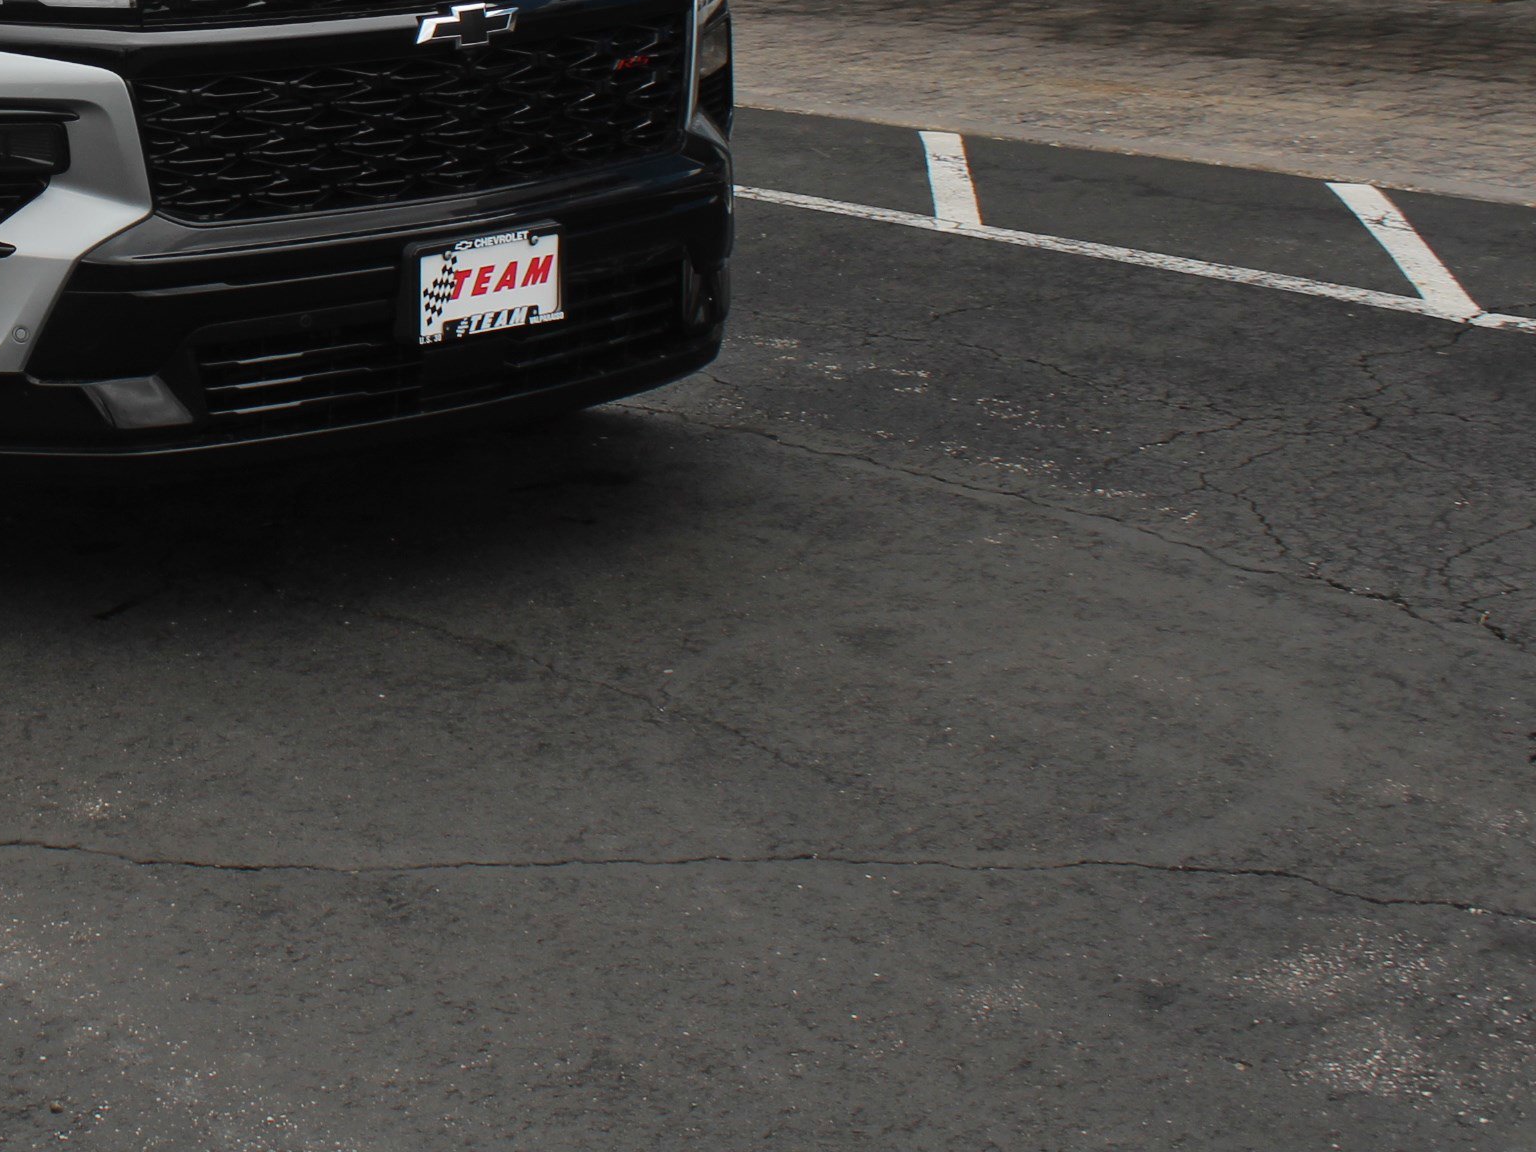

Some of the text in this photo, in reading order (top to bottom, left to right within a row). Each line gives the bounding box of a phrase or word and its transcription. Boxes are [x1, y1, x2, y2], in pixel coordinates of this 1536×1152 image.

[473, 230, 530, 248] CHEVROLET
[450, 254, 554, 300] TEAM
[468, 305, 530, 334] TEAM
